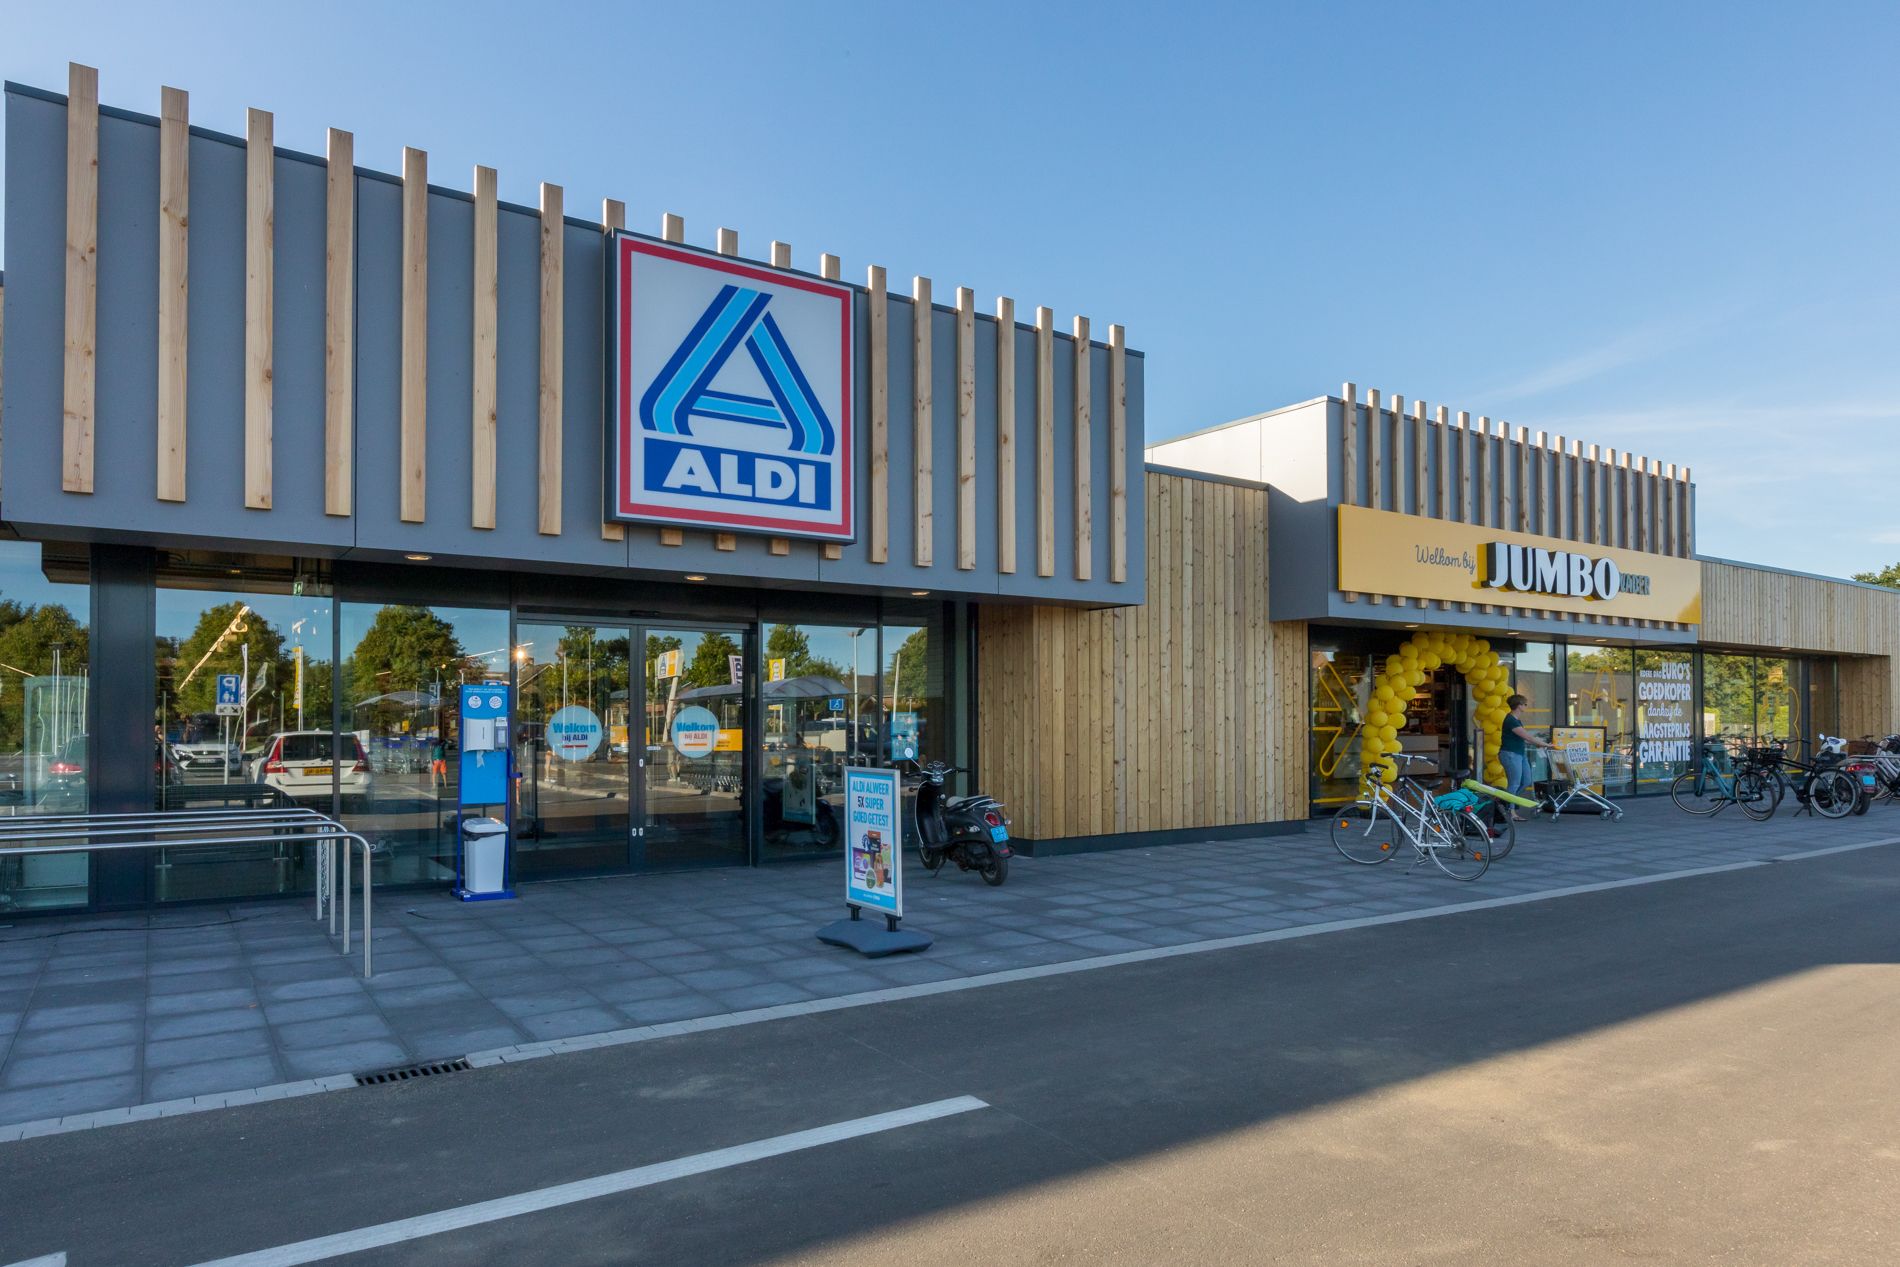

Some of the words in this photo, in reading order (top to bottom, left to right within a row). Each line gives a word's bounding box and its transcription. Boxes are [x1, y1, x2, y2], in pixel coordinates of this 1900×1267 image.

[662, 448, 815, 504] ALDI
[1415, 544, 1462, 568] Welkom
[1462, 551, 1476, 575] bij
[1486, 542, 1620, 600] JUMBO
[1661, 661, 1690, 681] EURO'S
[1639, 681, 1691, 701] GOEDKOPER
[1647, 703, 1673, 720] dankzij
[1674, 703, 1682, 717] de
[553, 722, 597, 733] Welkom
[676, 722, 716, 732] Welkom
[1640, 721, 1690, 739] LAAGSTEPRIJS
[562, 734, 571, 742] bij
[684, 732, 693, 741] bij
[1639, 741, 1691, 763] GARANTIE
[853, 780, 865, 792] ALDI
[866, 781, 889, 795] ALWEER
[857, 795, 864, 808] 5X
[865, 797, 884, 810] SUPER
[853, 810, 867, 823] GOED
[868, 812, 889, 827] GETEST
